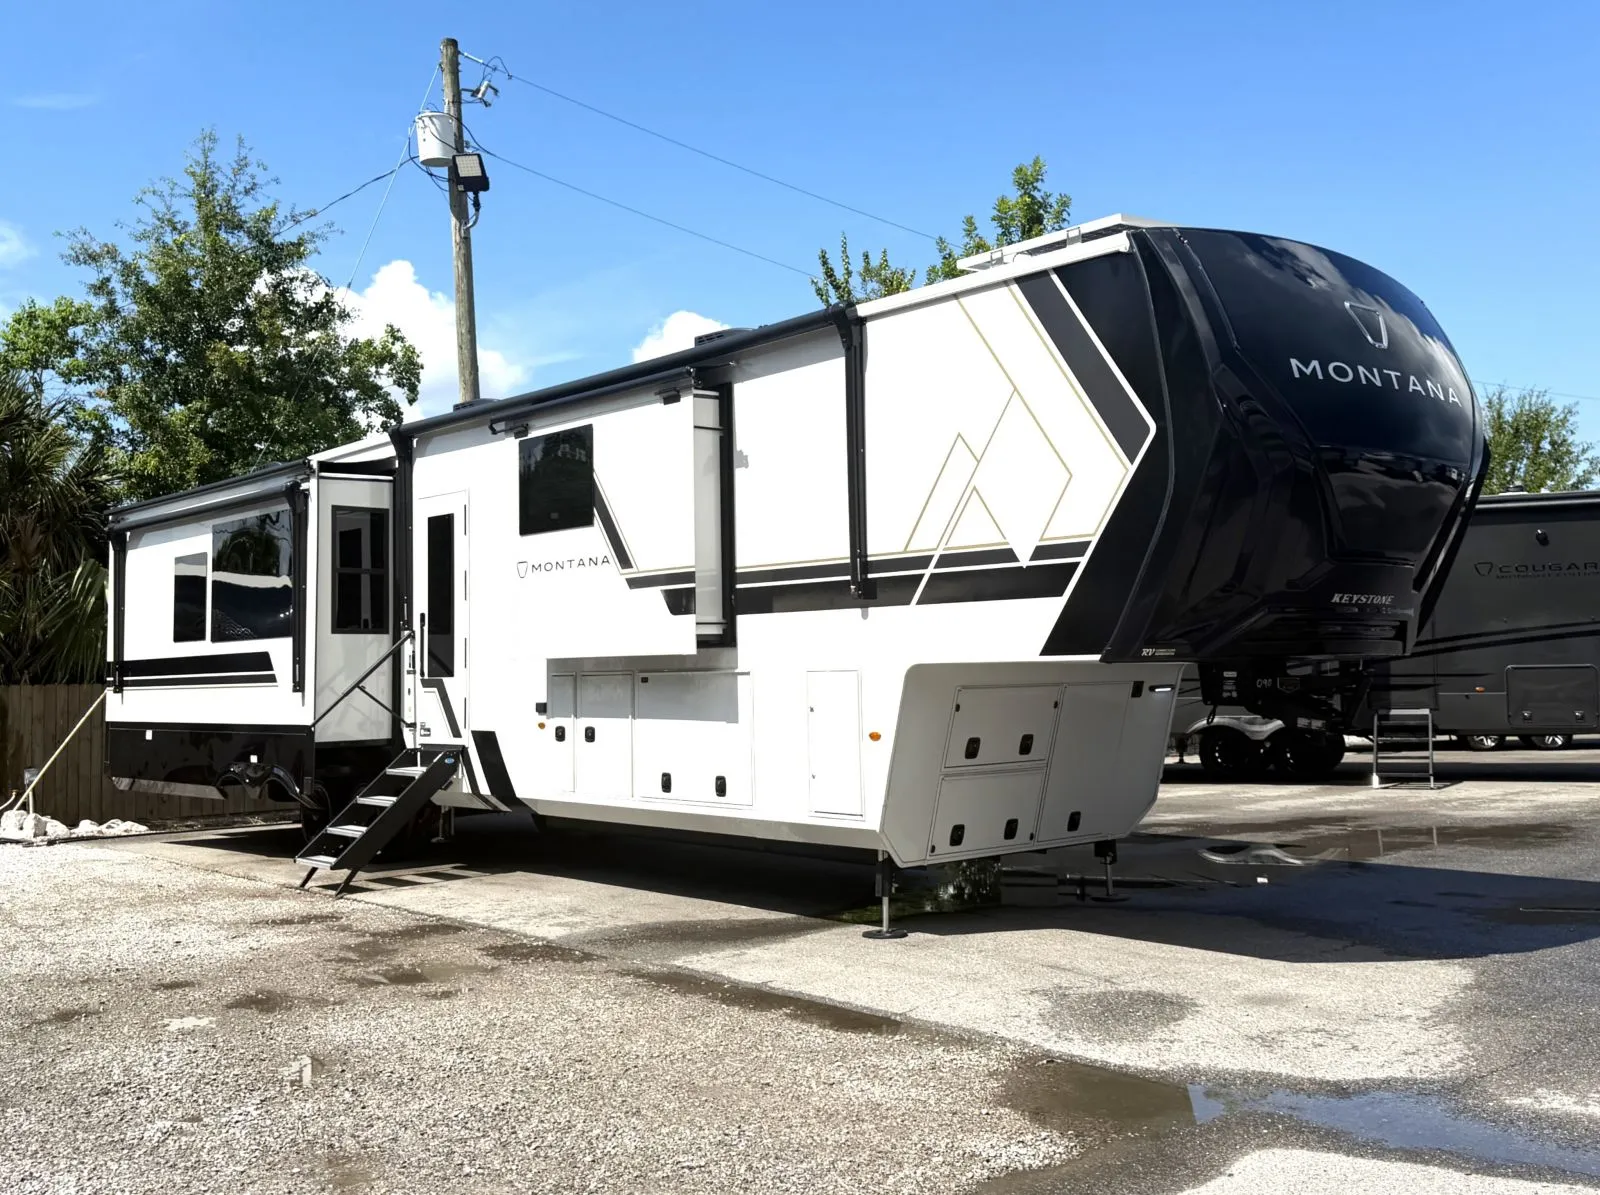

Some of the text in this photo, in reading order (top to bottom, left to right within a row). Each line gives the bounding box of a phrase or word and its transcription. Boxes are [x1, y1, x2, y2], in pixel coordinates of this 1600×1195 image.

[1289, 357, 1463, 408] MONTANA
[531, 555, 610, 573] MONTANA
[1498, 562, 1599, 574] COUGAR
[1331, 593, 1395, 605] KEYSTONE
[1141, 648, 1156, 657] RV
